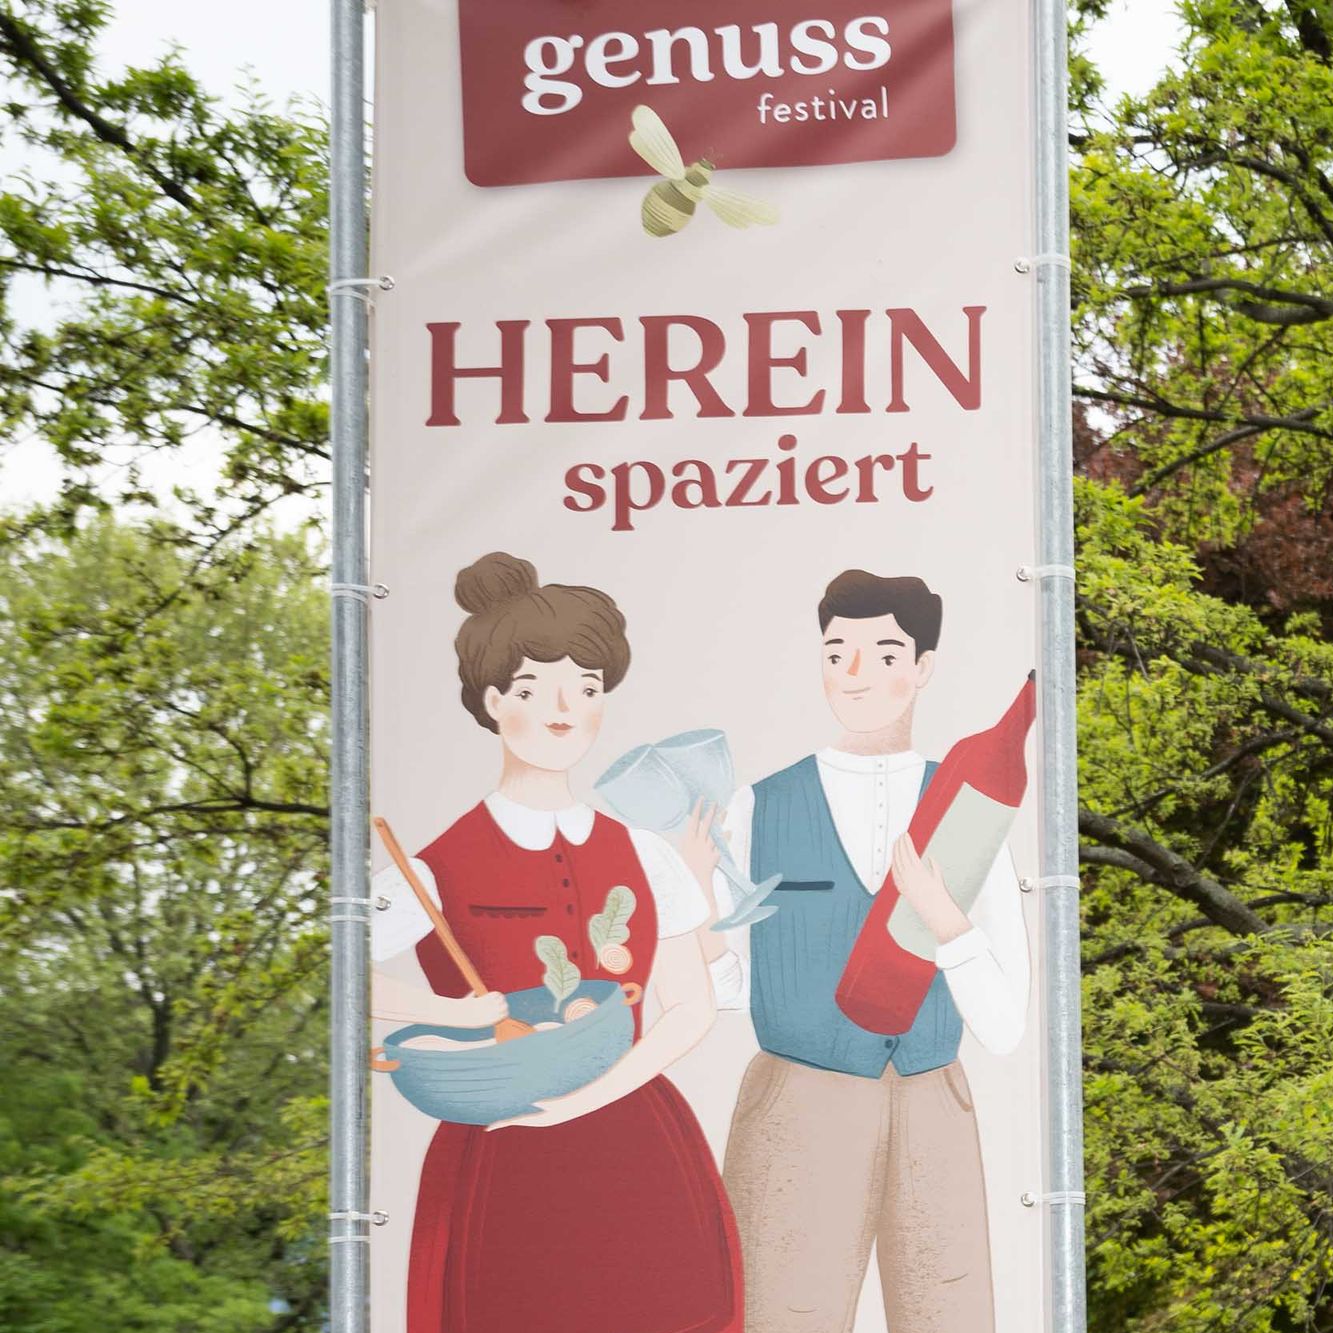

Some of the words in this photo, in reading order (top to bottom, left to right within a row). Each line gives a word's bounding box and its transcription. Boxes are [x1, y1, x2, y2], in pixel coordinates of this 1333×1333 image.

[522, 14, 892, 116] genuss
[757, 86, 889, 123] festival
[425, 305, 987, 427] HEREIN
[562, 434, 934, 531] spaziert
